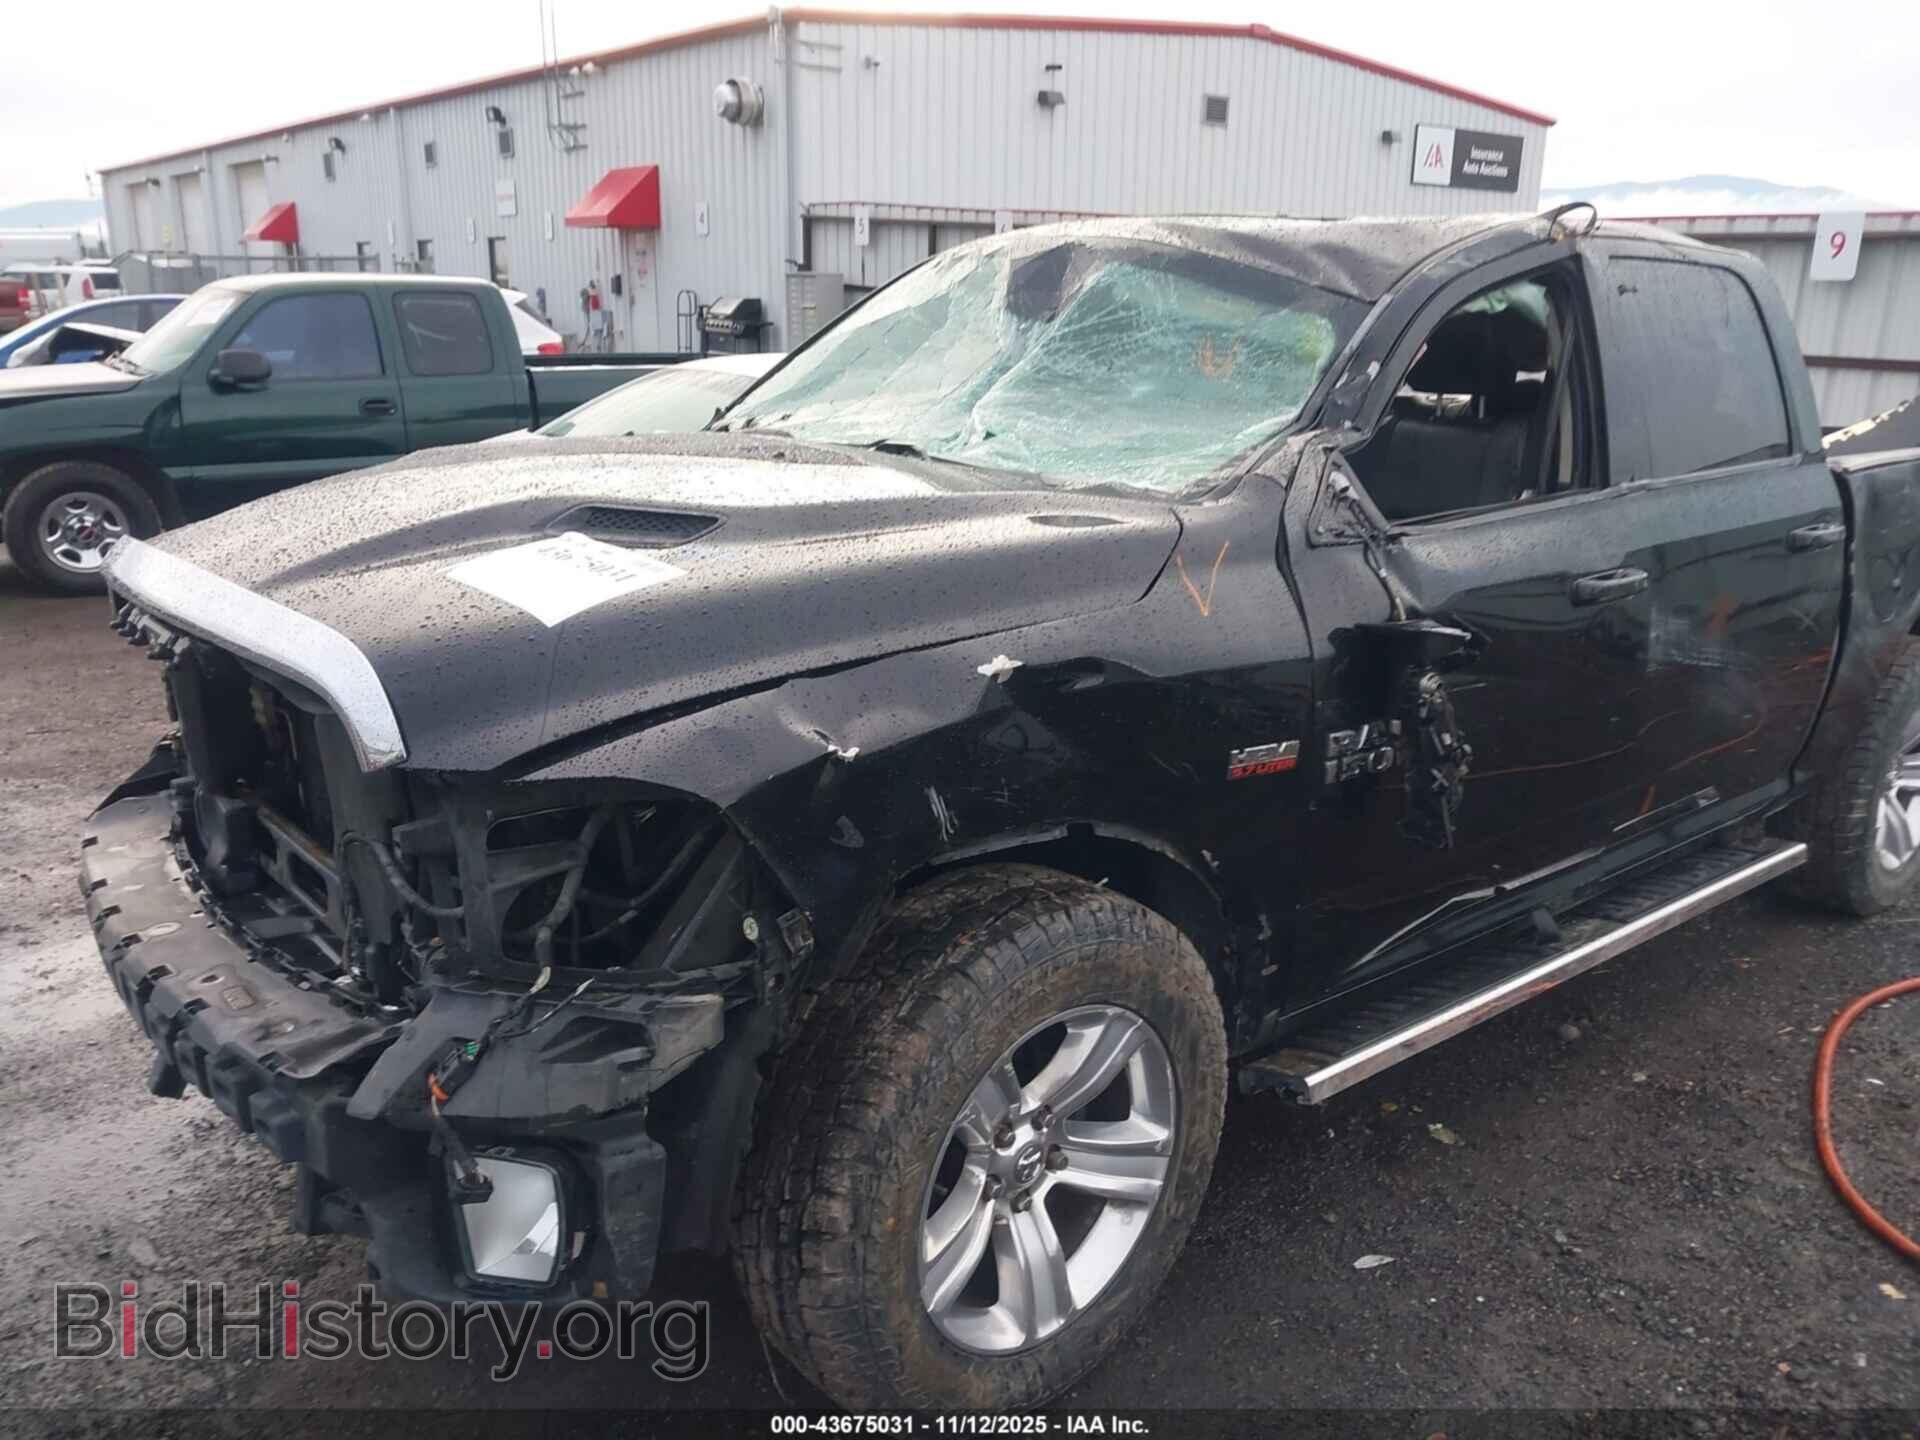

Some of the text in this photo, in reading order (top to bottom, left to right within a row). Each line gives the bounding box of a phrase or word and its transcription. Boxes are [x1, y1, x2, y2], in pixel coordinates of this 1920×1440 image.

[1470, 145, 1504, 162] Insurance
[1463, 160, 1508, 177] Auto Auctions
[1830, 231, 1846, 260] 9
[1328, 720, 1402, 757] RA
[1324, 746, 1397, 785] 150
